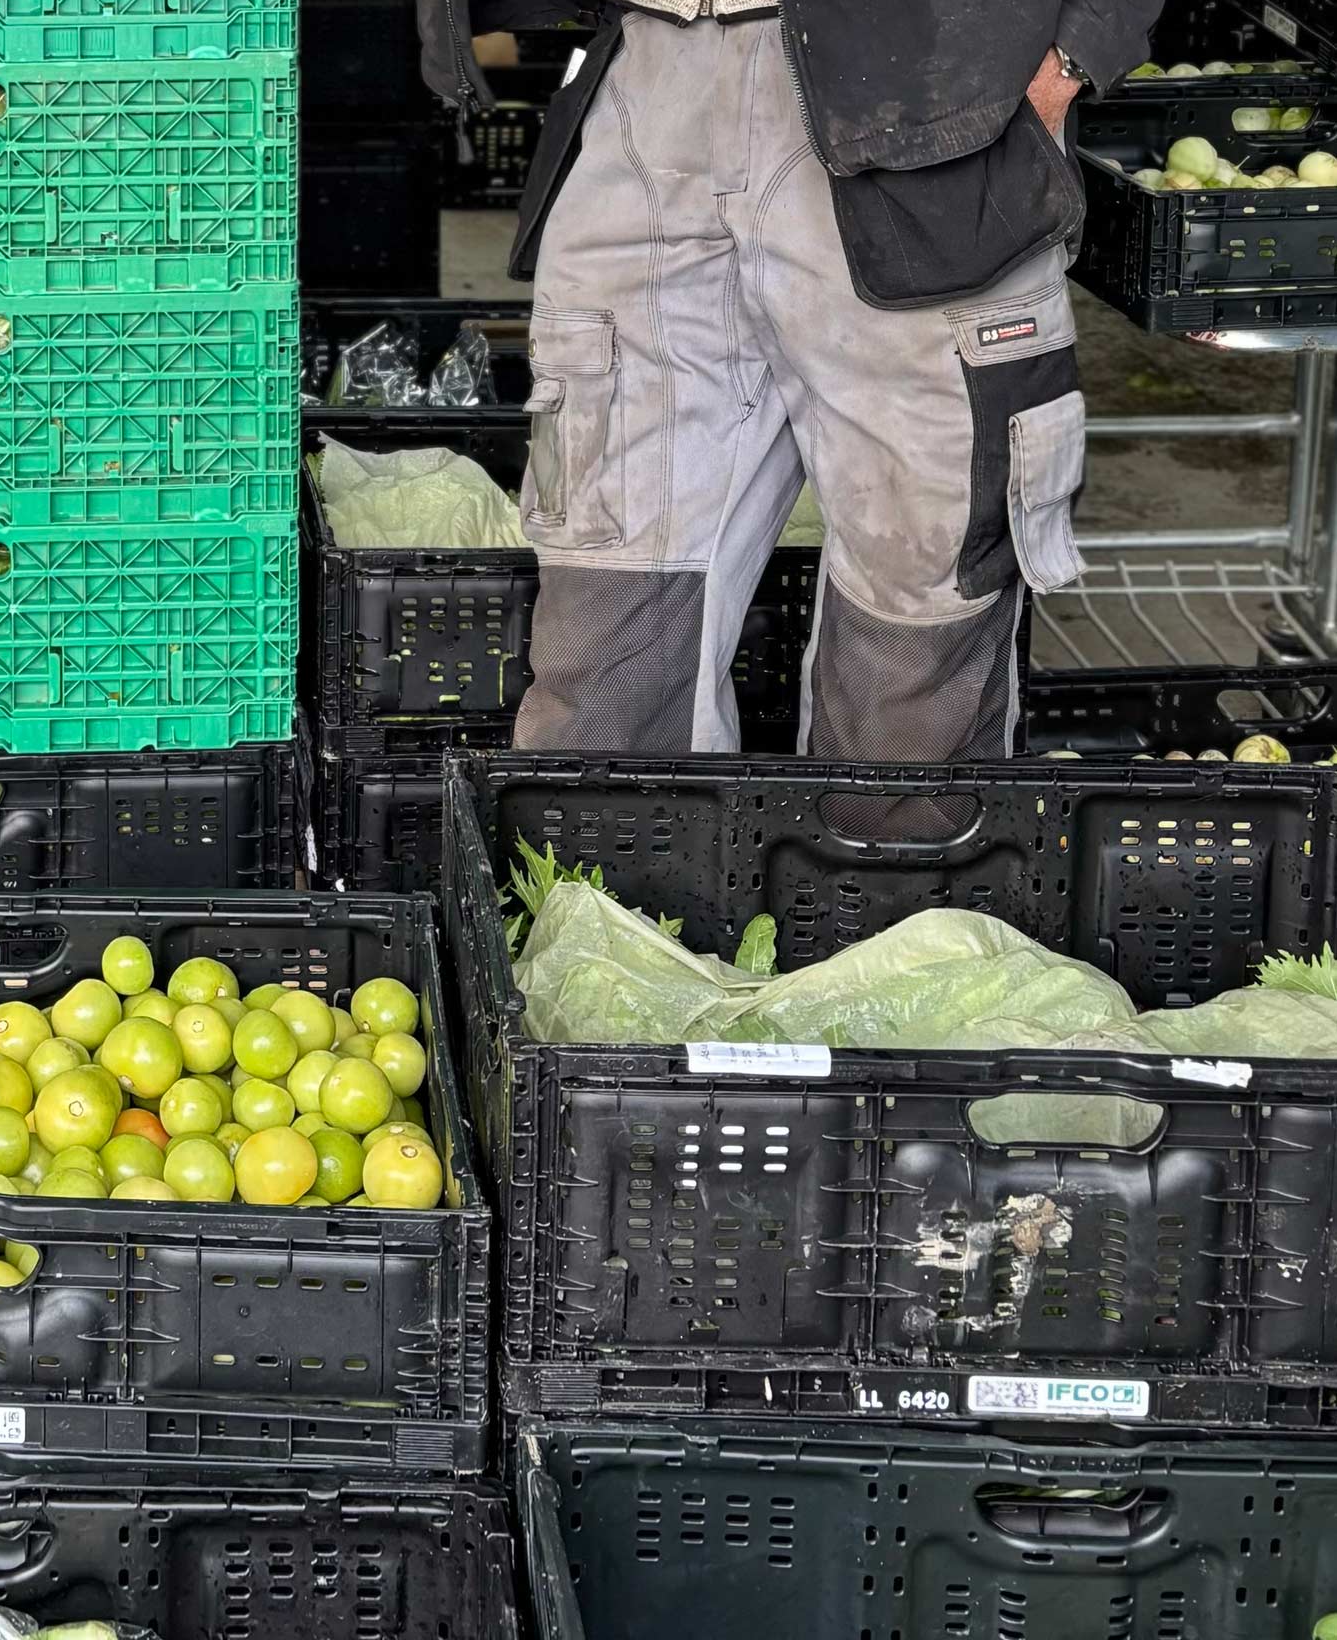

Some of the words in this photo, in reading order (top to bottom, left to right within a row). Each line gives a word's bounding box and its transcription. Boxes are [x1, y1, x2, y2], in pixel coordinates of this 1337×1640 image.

[859, 1390, 883, 1409] LL
[898, 1390, 950, 1410] 6420
[1047, 1383, 1109, 1402] IFCO
